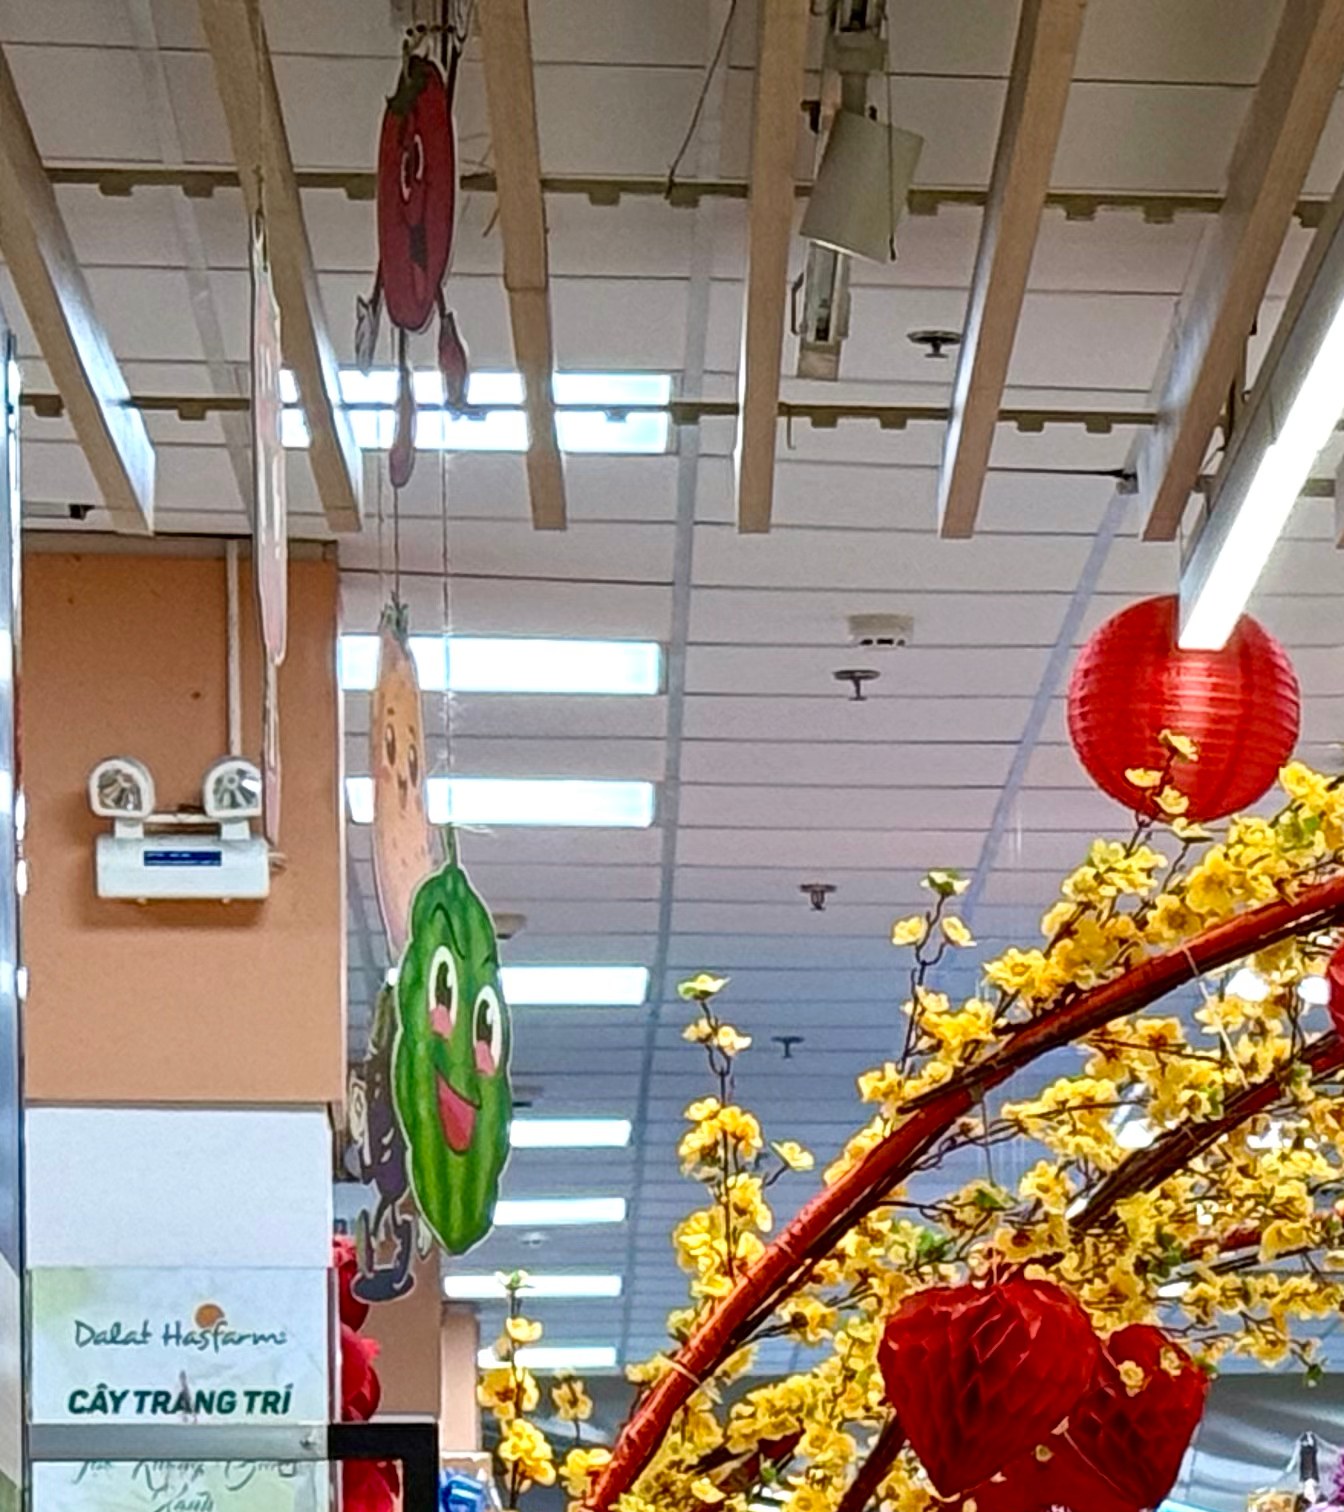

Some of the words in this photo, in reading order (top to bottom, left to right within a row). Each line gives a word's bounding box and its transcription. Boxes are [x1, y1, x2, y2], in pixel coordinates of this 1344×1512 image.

[75, 1320, 152, 1347] Dalat
[68, 1383, 131, 1414] CÂY
[133, 1389, 237, 1414] TRANG
[244, 1383, 294, 1414] TRÍ
